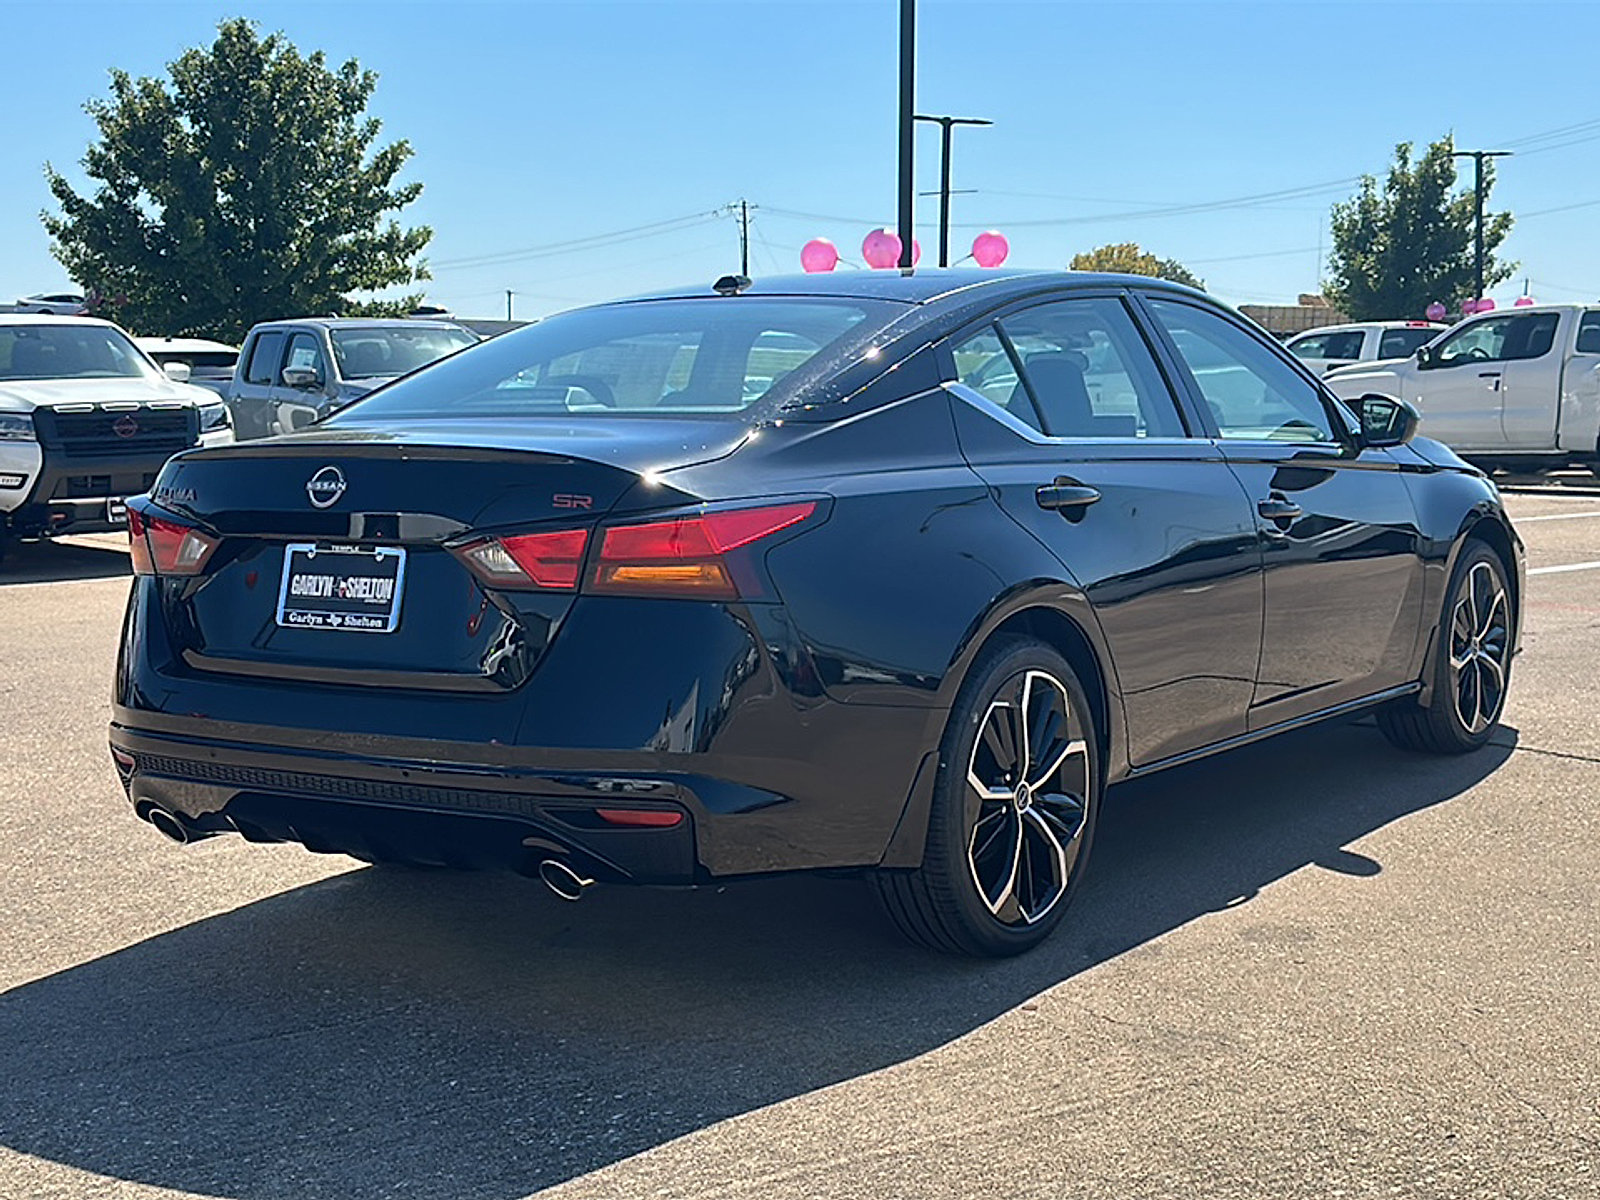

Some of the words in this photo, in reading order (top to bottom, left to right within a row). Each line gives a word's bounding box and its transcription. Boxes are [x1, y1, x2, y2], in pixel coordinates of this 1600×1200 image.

[306, 481, 347, 491] NISSAN
[552, 494, 593, 509] SR
[291, 574, 334, 597] GARLYN
[345, 577, 394, 599] SHELTON
[288, 612, 323, 626] Garlyn
[343, 615, 383, 628] Shelton
